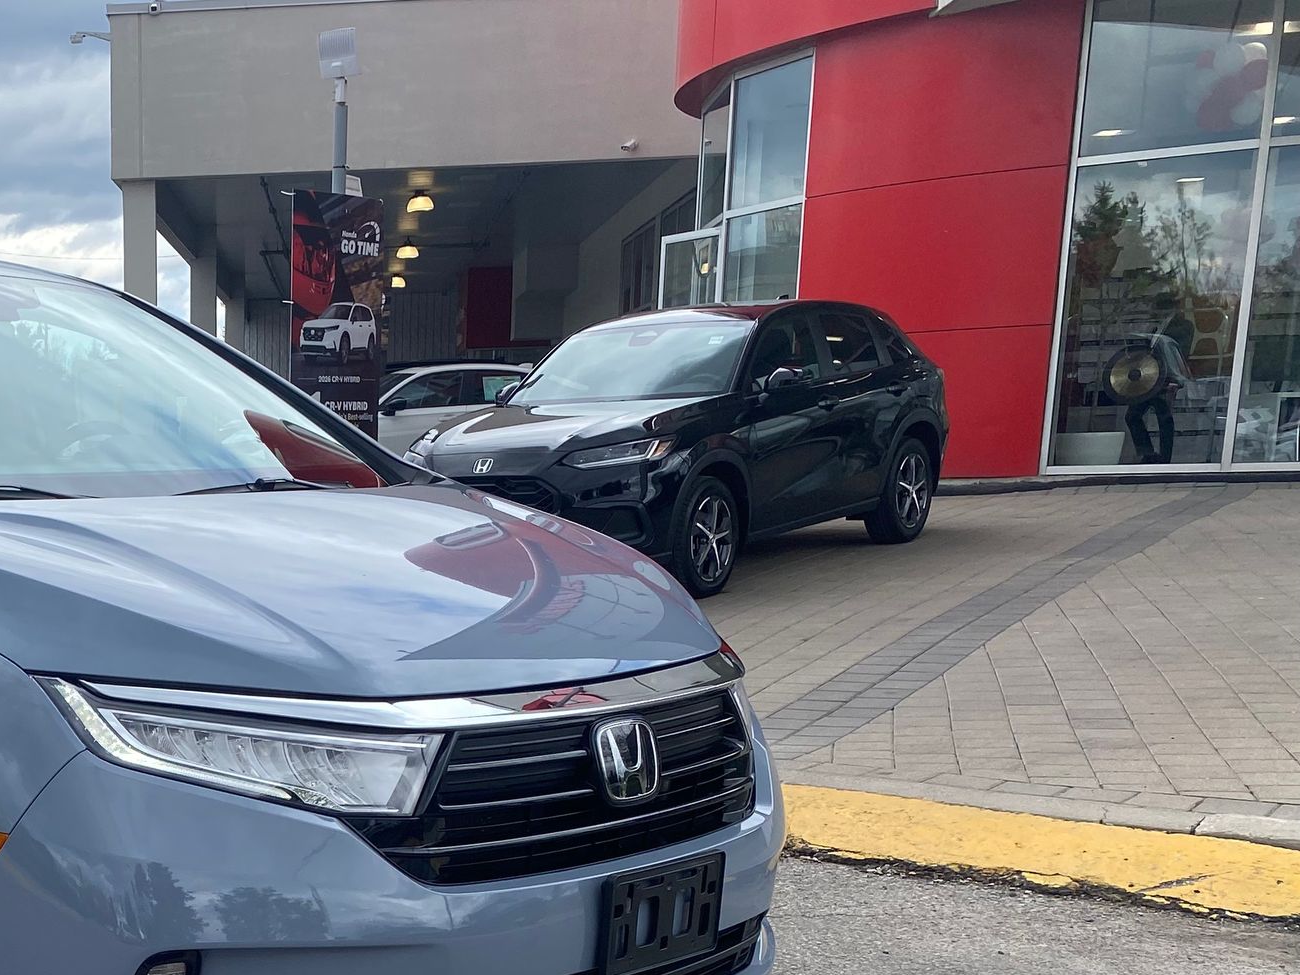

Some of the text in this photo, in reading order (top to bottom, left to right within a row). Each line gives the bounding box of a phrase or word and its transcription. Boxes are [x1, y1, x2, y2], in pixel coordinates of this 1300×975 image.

[341, 239, 379, 257] GO TIME
[324, 401, 368, 411] CR-V HYBRID
